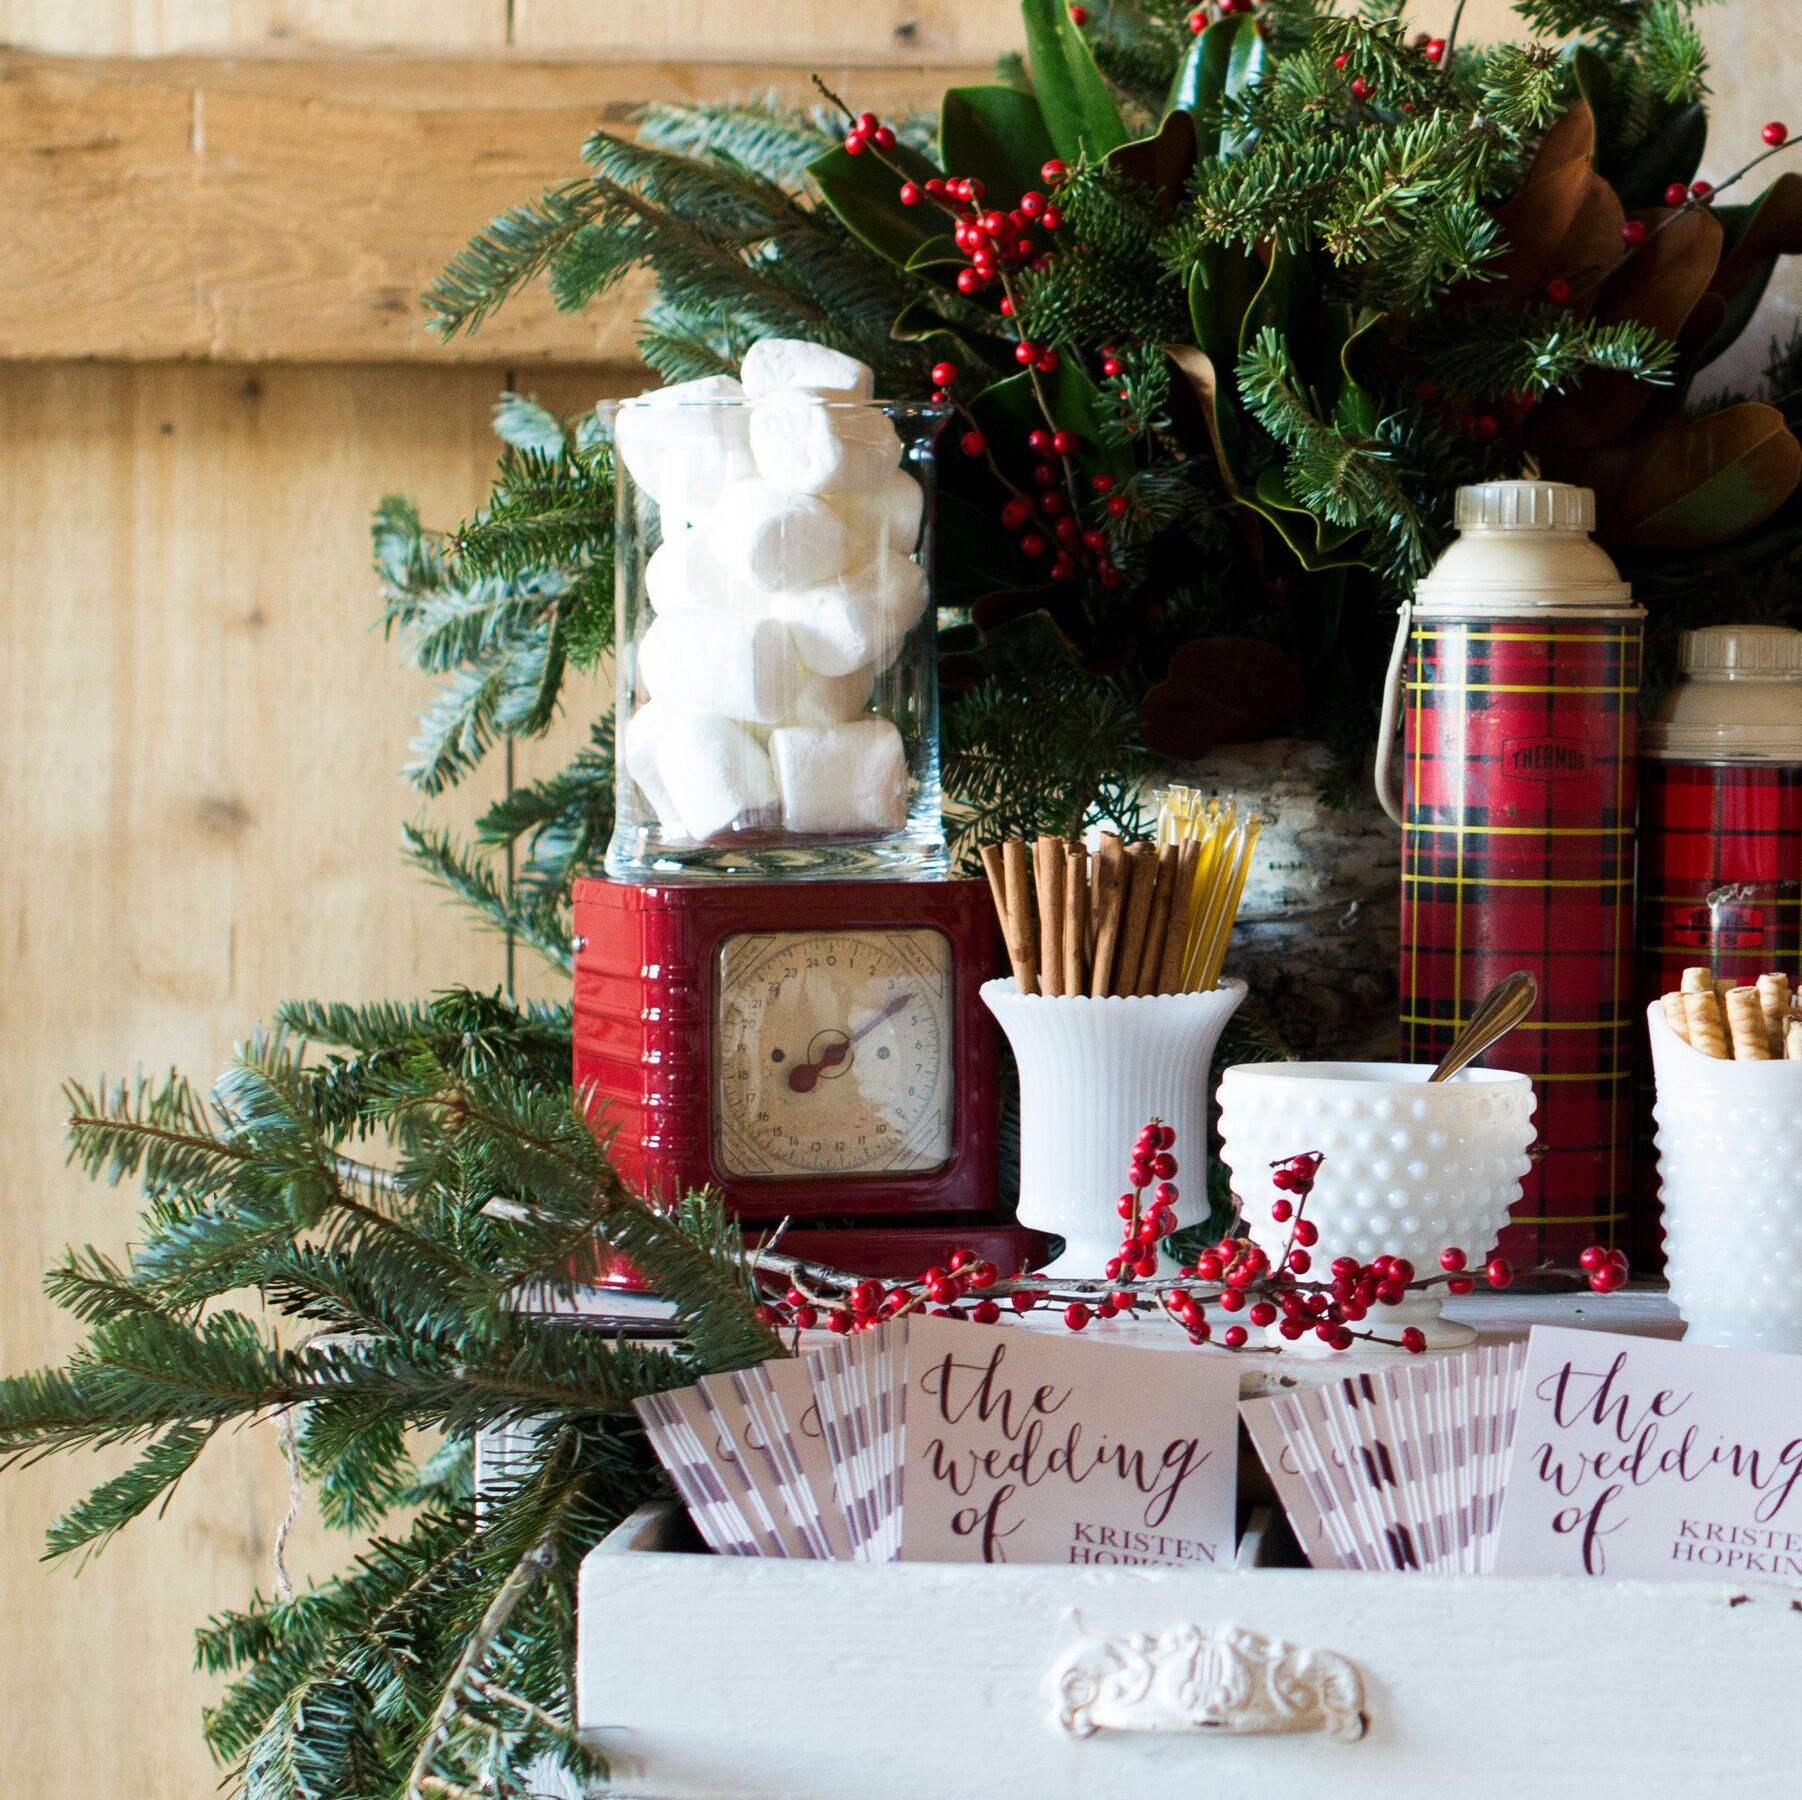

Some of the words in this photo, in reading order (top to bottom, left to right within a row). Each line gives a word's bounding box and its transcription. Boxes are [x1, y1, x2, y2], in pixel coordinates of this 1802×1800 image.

[1512, 745, 1585, 769] THERMOS
[784, 968, 797, 978] 23
[868, 966, 876, 975] 2
[888, 980, 895, 990] 3
[911, 1016, 918, 1025] 5
[915, 1040, 922, 1050] 6
[915, 1063, 922, 1073] 7
[772, 1126, 783, 1136] 15
[876, 1124, 887, 1134] 10
[789, 1136, 800, 1146] 14
[835, 1141, 846, 1151] 12
[811, 1142, 822, 1152] 13
[920, 1343, 1072, 1440] the
[1536, 1351, 1693, 1436] the
[921, 1420, 1212, 1528] wedding
[951, 1485, 1024, 1563] of
[1551, 1484, 1628, 1576] of
[1074, 1521, 1217, 1563] KRISTEN
